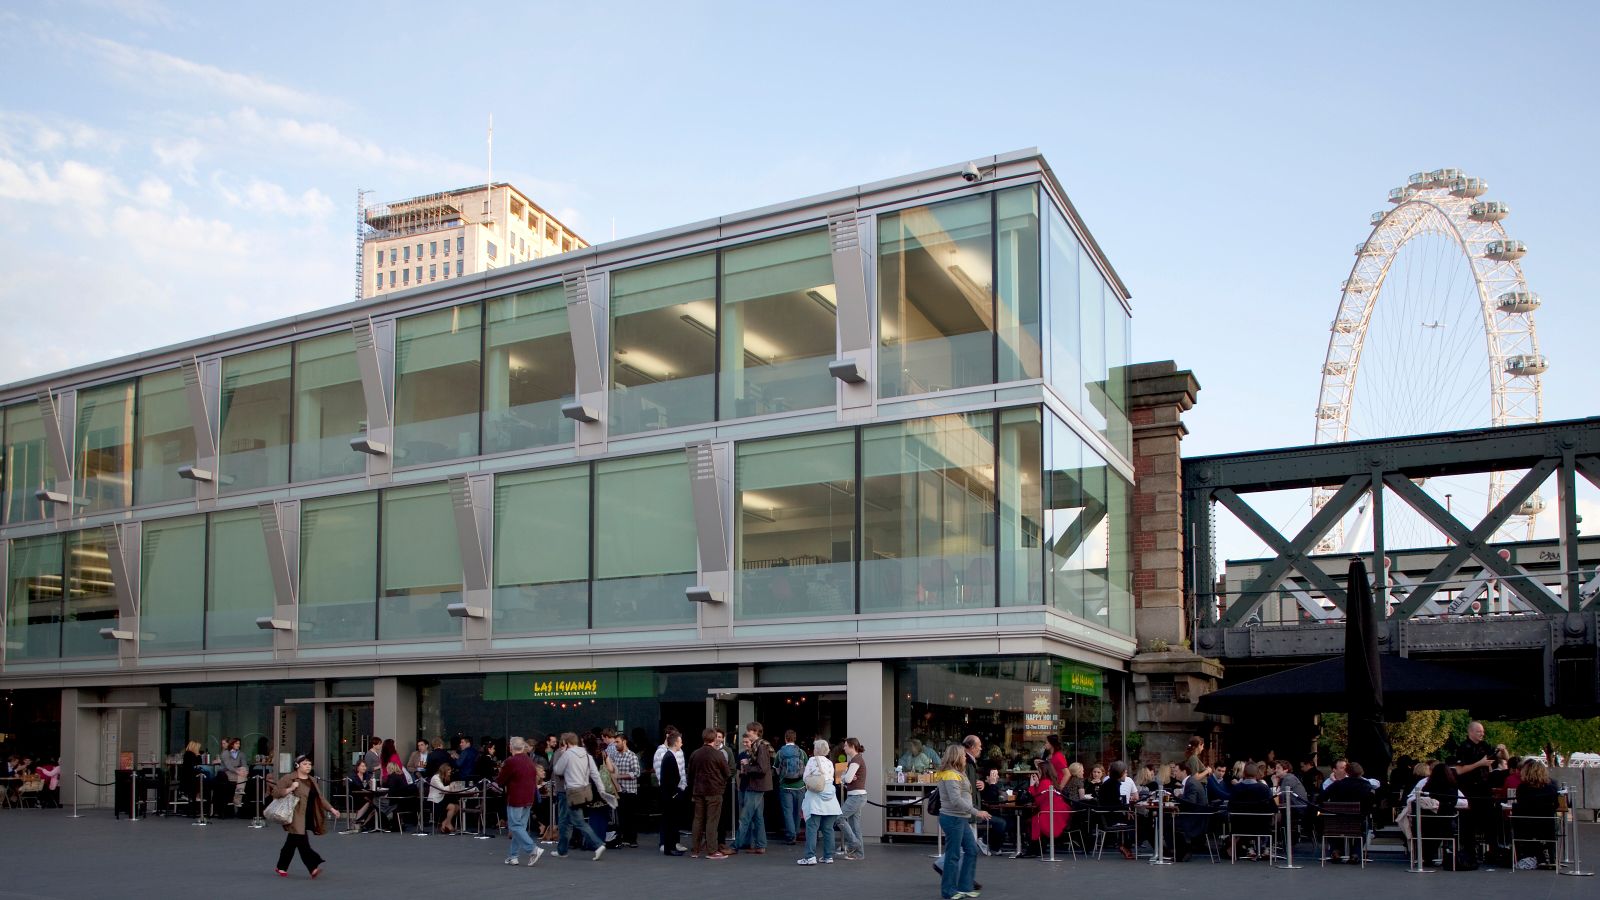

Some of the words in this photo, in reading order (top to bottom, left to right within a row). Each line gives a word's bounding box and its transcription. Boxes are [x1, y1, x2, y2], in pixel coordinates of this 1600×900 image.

[534, 681, 553, 692] LAS
[555, 680, 597, 691] IGUANAS
[1025, 713, 1042, 721] HAPPY
